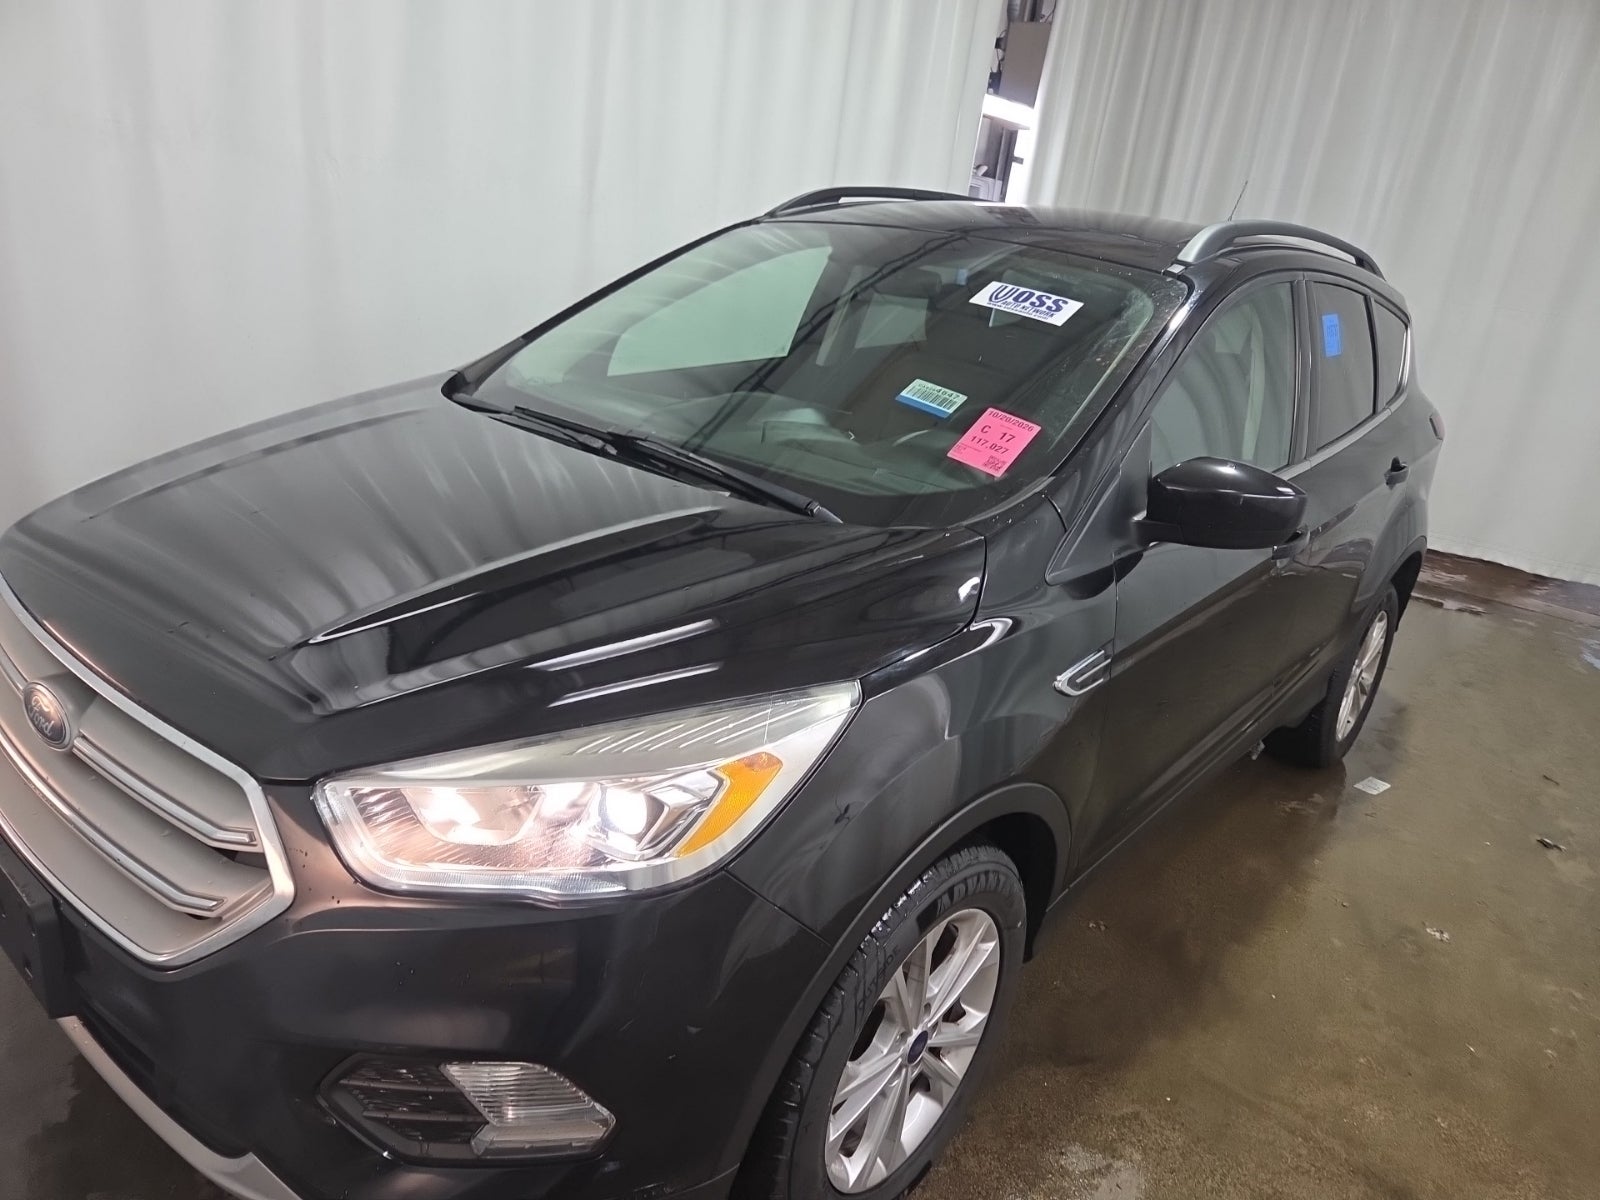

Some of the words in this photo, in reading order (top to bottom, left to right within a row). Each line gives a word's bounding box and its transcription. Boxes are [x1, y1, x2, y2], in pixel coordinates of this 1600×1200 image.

[988, 284, 1068, 312] VOSS
[1001, 300, 1022, 309] AUTO
[1021, 304, 1055, 318] NETWORK
[980, 424, 992, 434] C
[999, 432, 1016, 443] 17
[29, 695, 55, 736] Ford
